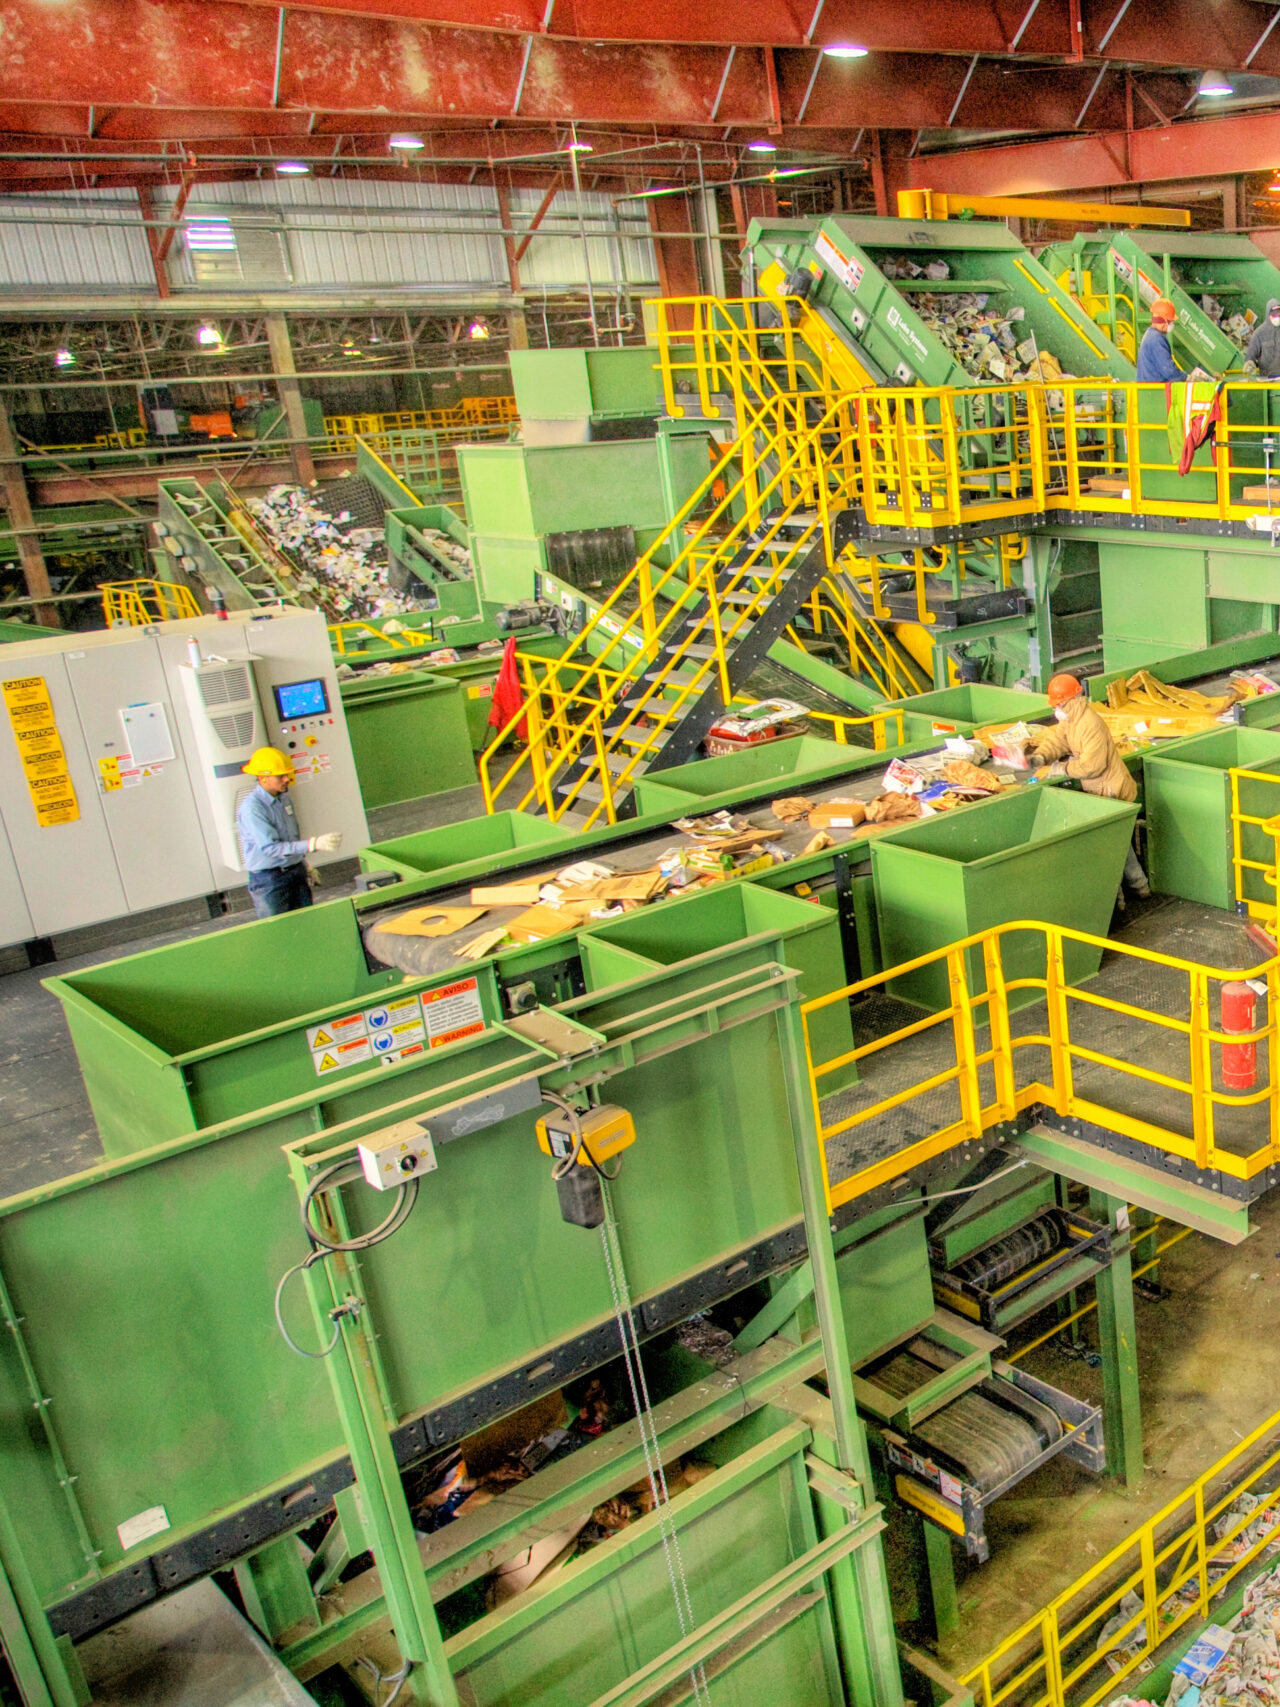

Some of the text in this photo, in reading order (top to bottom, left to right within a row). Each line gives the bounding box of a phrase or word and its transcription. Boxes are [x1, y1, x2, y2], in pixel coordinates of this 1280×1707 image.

[4, 678, 41, 690] CAUTION
[18, 727, 55, 740] CAUTION
[31, 776, 67, 788] CAUTION
[443, 982, 469, 996] AVISO
[444, 1025, 482, 1042] WARNING
